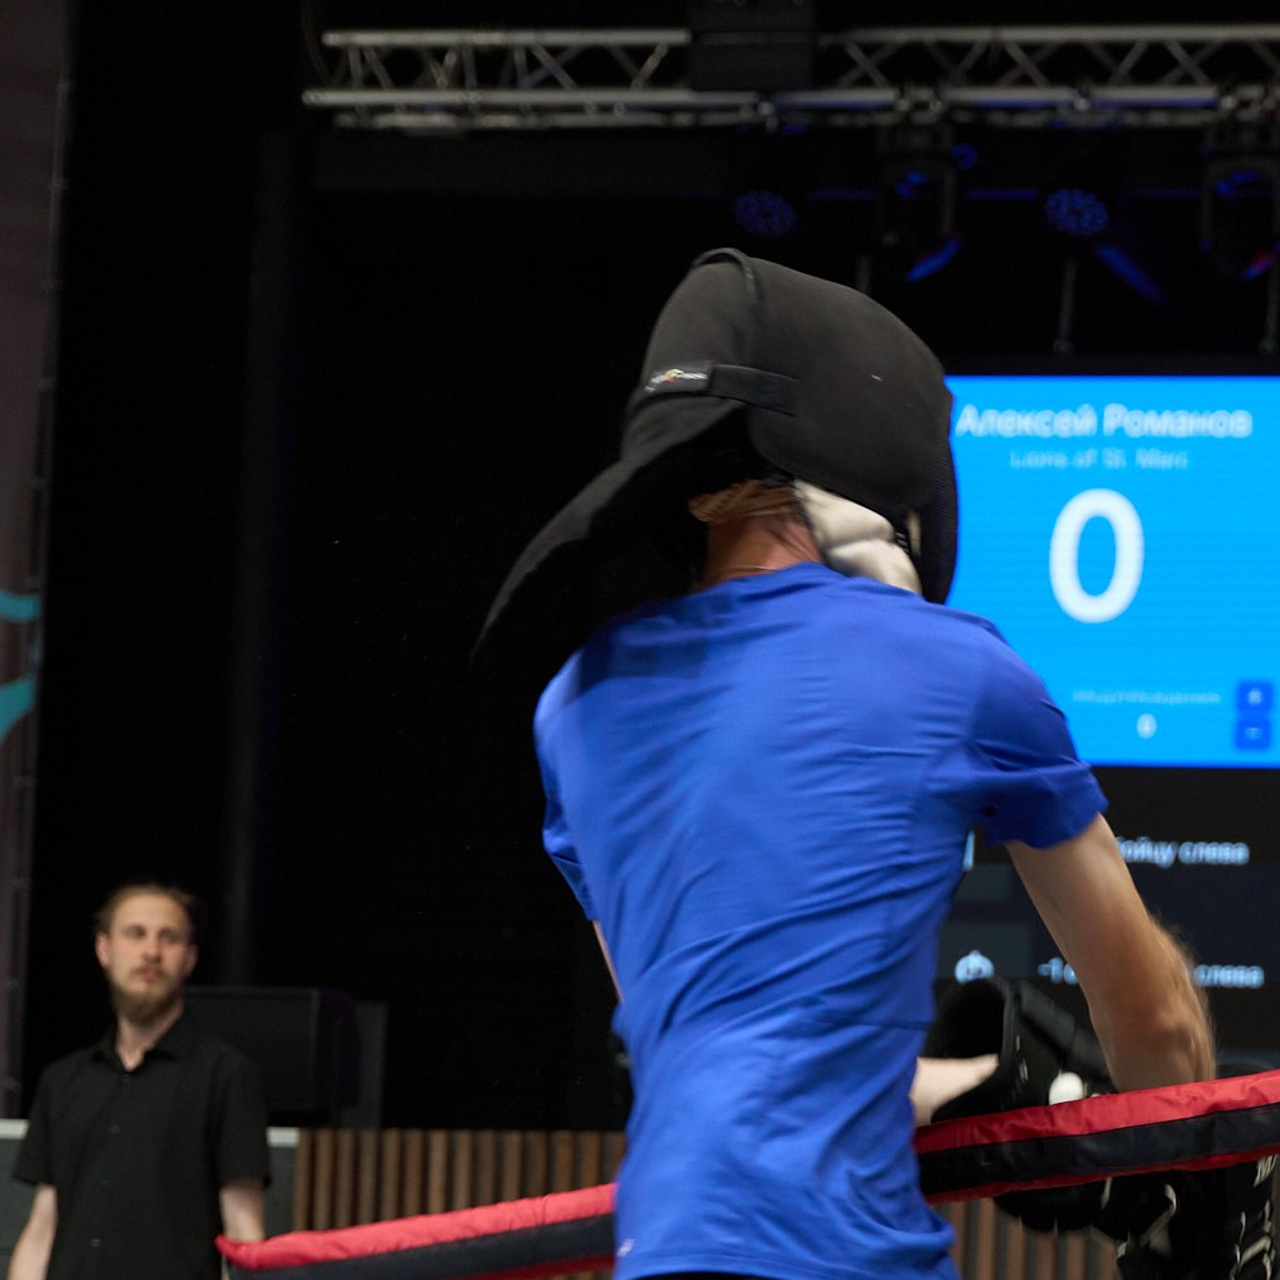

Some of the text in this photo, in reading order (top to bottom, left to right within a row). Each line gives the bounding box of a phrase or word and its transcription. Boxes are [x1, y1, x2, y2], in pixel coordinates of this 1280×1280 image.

[955, 402, 1253, 438] Алексей Романов
[1049, 488, 1145, 624] 0
[1116, 836, 1178, 868] ойцу
